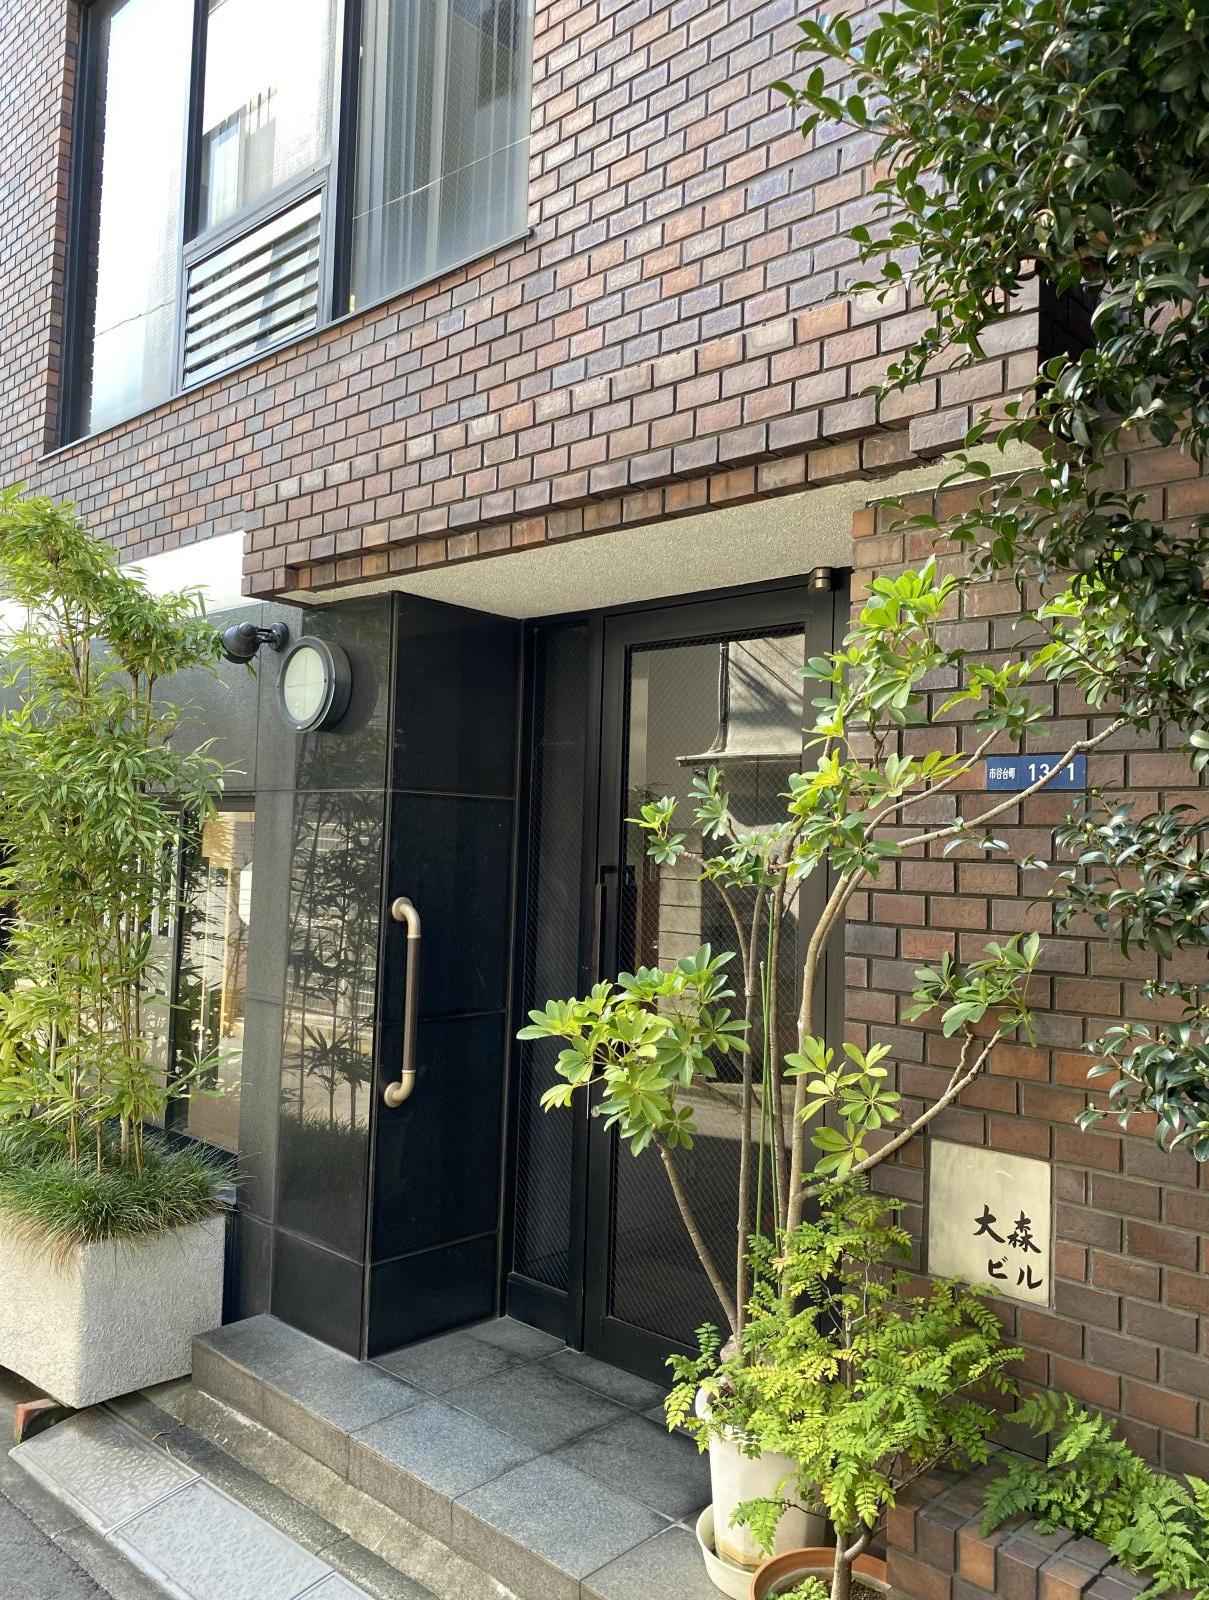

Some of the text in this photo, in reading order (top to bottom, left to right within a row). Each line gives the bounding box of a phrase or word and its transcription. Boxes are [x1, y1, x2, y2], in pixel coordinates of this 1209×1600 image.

[989, 762, 1075, 782] 市谷台町 131
[972, 1204, 1042, 1254] 大森
[987, 1256, 1043, 1290] ビル
